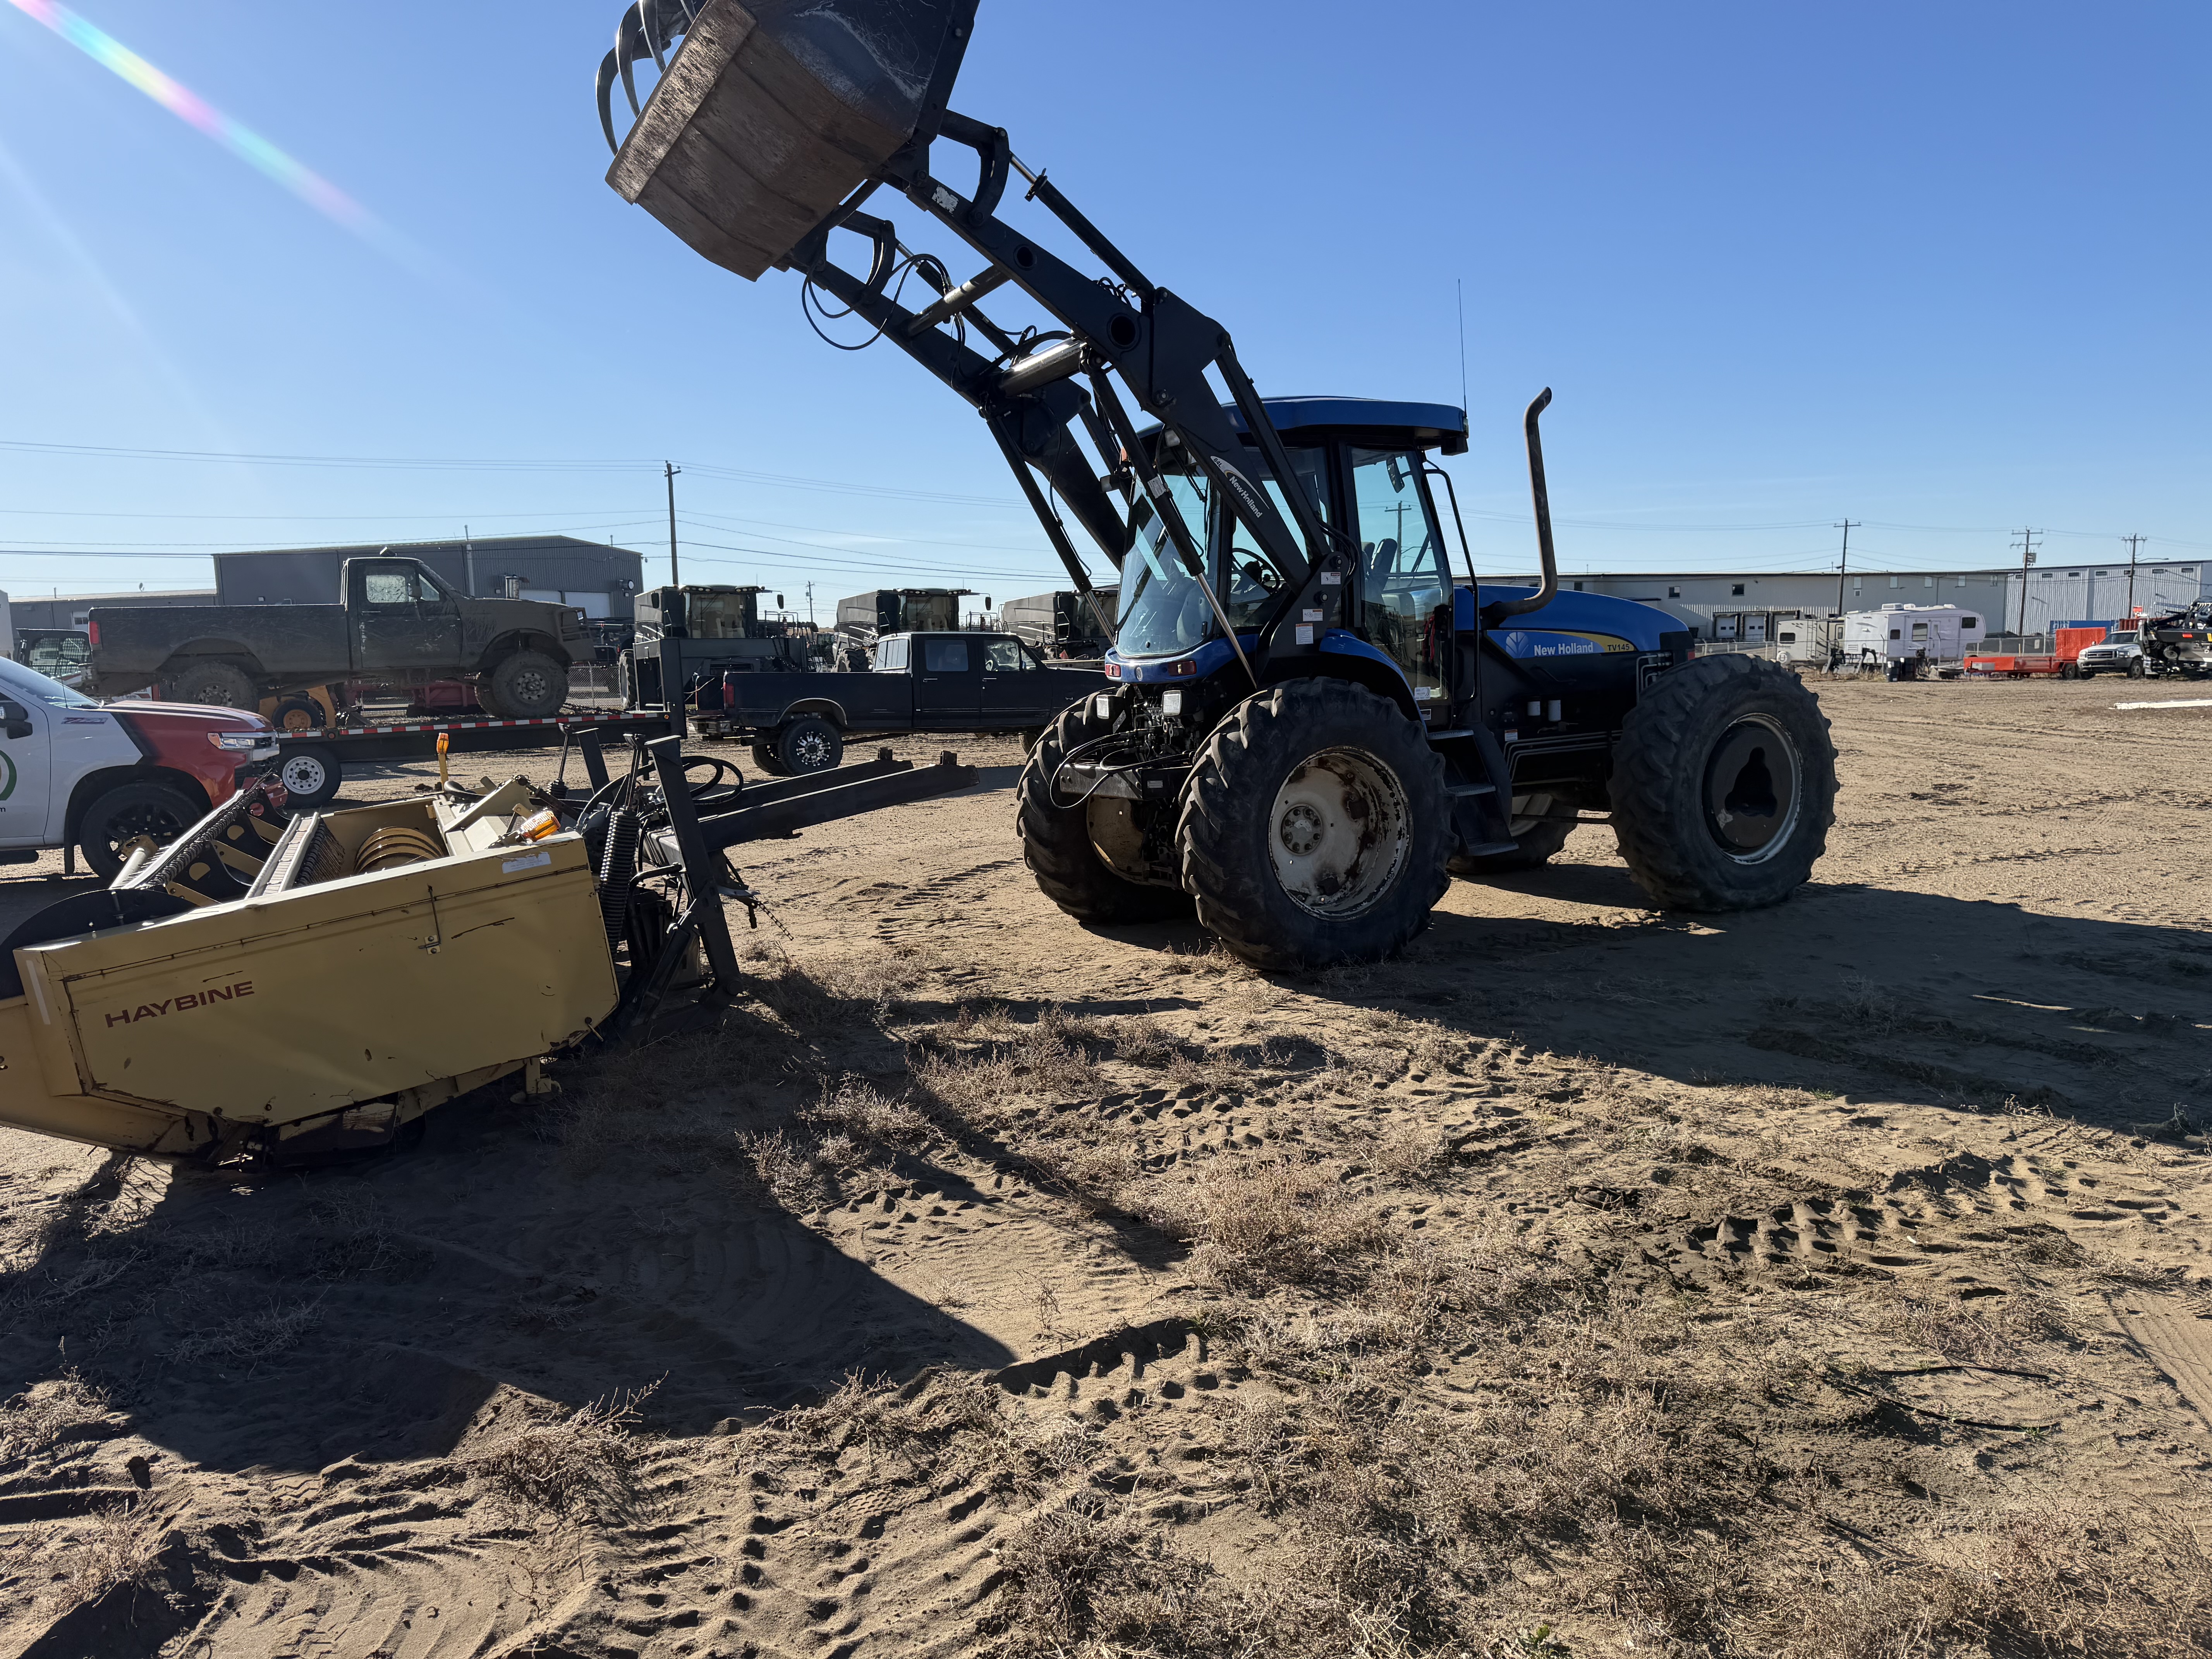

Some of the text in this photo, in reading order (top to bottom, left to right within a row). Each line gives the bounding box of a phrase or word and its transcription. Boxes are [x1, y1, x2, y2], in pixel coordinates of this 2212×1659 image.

[1229, 476, 1262, 518] New Holland
[1534, 642, 1594, 656] New Holland
[105, 981, 255, 1028] HAYBINE
